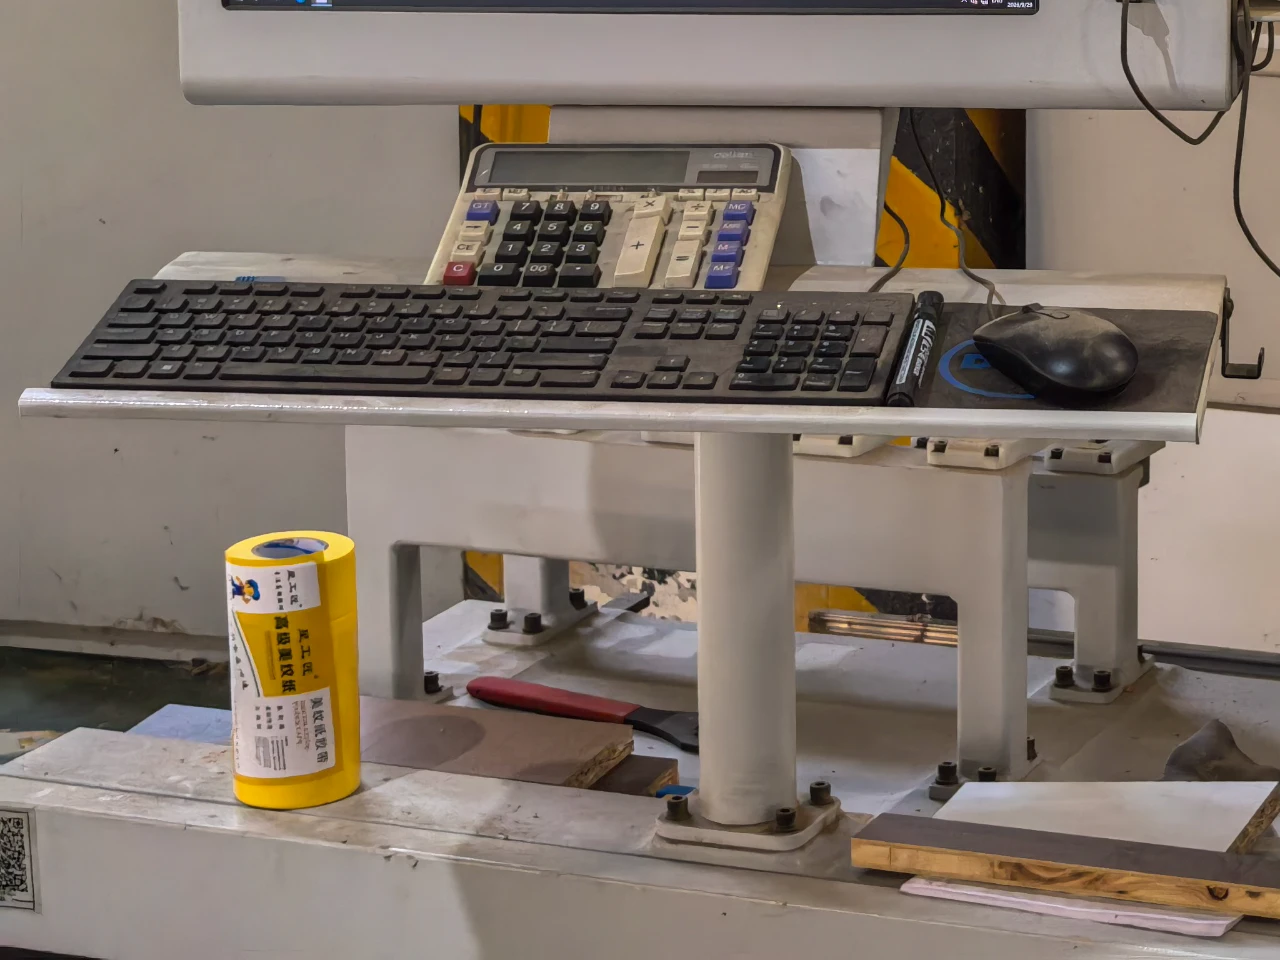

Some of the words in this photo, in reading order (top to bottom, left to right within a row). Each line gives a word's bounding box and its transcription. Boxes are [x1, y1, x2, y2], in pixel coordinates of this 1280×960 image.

[521, 202, 531, 210] 7
[554, 202, 564, 211] 8
[590, 202, 600, 210] 9
[513, 223, 522, 231] 4
[548, 223, 557, 231] 5
[583, 223, 592, 231] 6
[541, 244, 551, 252] 2
[576, 244, 586, 252] 3
[453, 264, 463, 272] C
[493, 264, 503, 272] 0
